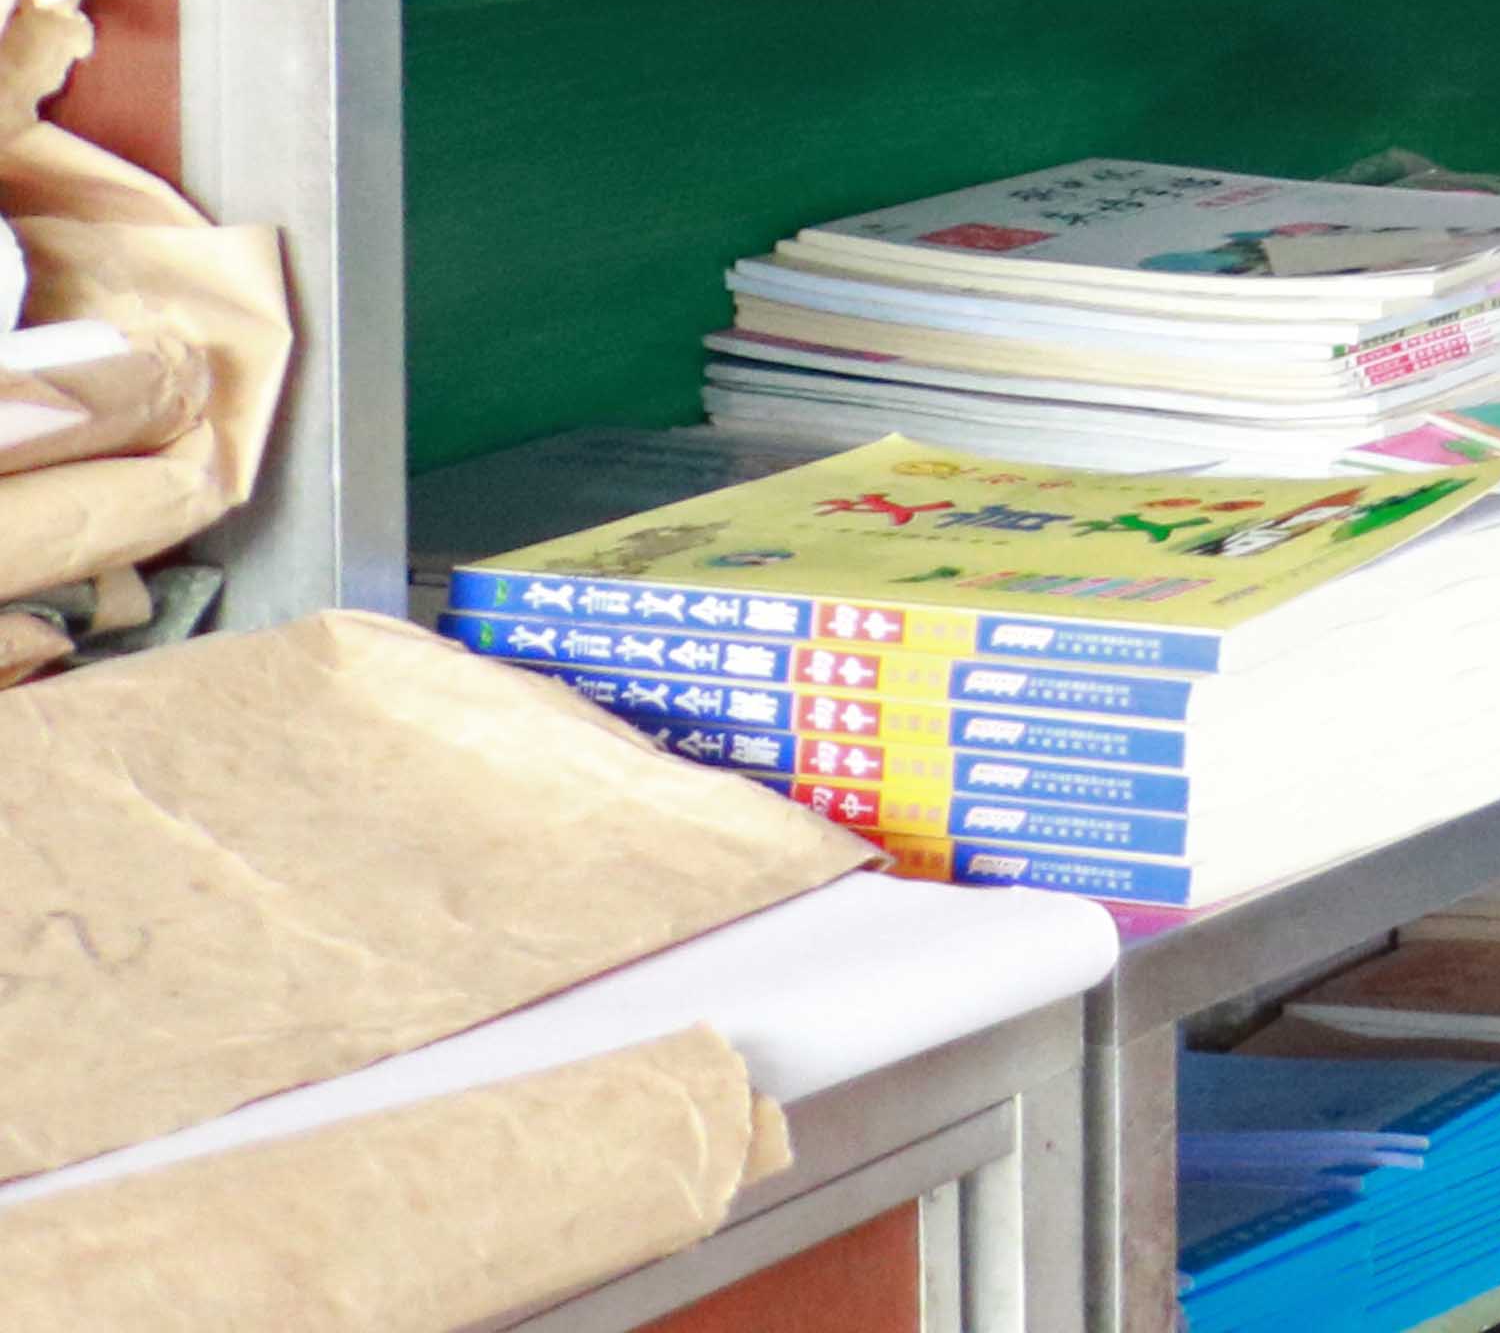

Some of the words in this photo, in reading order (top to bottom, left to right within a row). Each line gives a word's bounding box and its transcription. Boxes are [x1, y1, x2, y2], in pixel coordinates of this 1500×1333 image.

[522, 580, 801, 634] 文言文全解
[827, 605, 900, 641] 初中
[507, 624, 778, 679] 文言文全解
[804, 650, 875, 686] 初中
[572, 675, 779, 725] 言文全解
[806, 696, 877, 733] 初中
[809, 739, 880, 777] 初中
